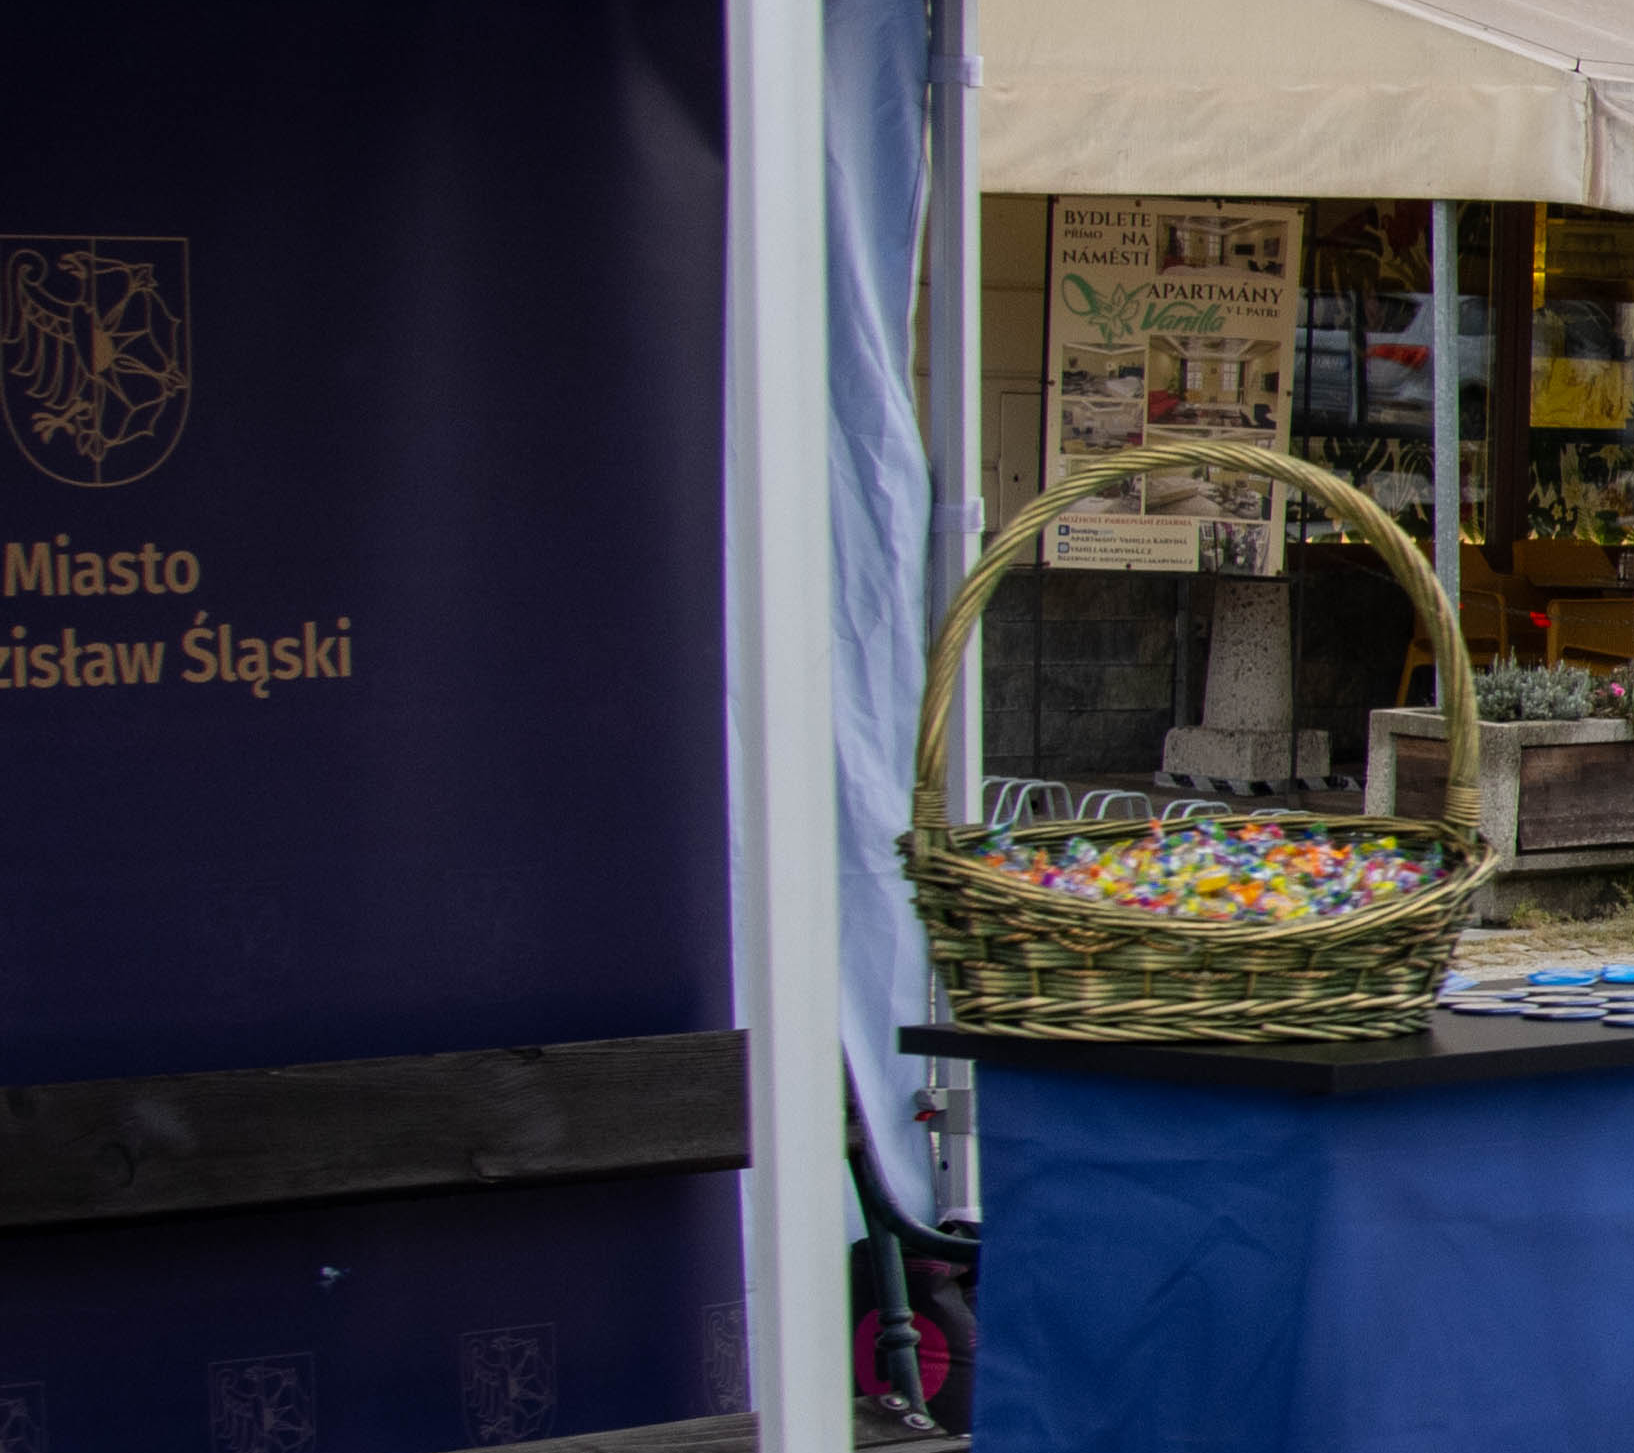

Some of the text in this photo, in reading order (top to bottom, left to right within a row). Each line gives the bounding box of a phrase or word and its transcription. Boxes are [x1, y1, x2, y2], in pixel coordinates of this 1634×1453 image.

[1064, 210, 1152, 228] BYDLETE
[1064, 227, 1149, 246] PŘÍMO NA
[1062, 246, 1149, 267] NÁMĚSTÍ
[1148, 282, 1284, 305] APARTMÁNY
[1141, 301, 1227, 333] Vanilla
[3, 534, 201, 597] Miasto
[181, 610, 353, 699] Śląski
